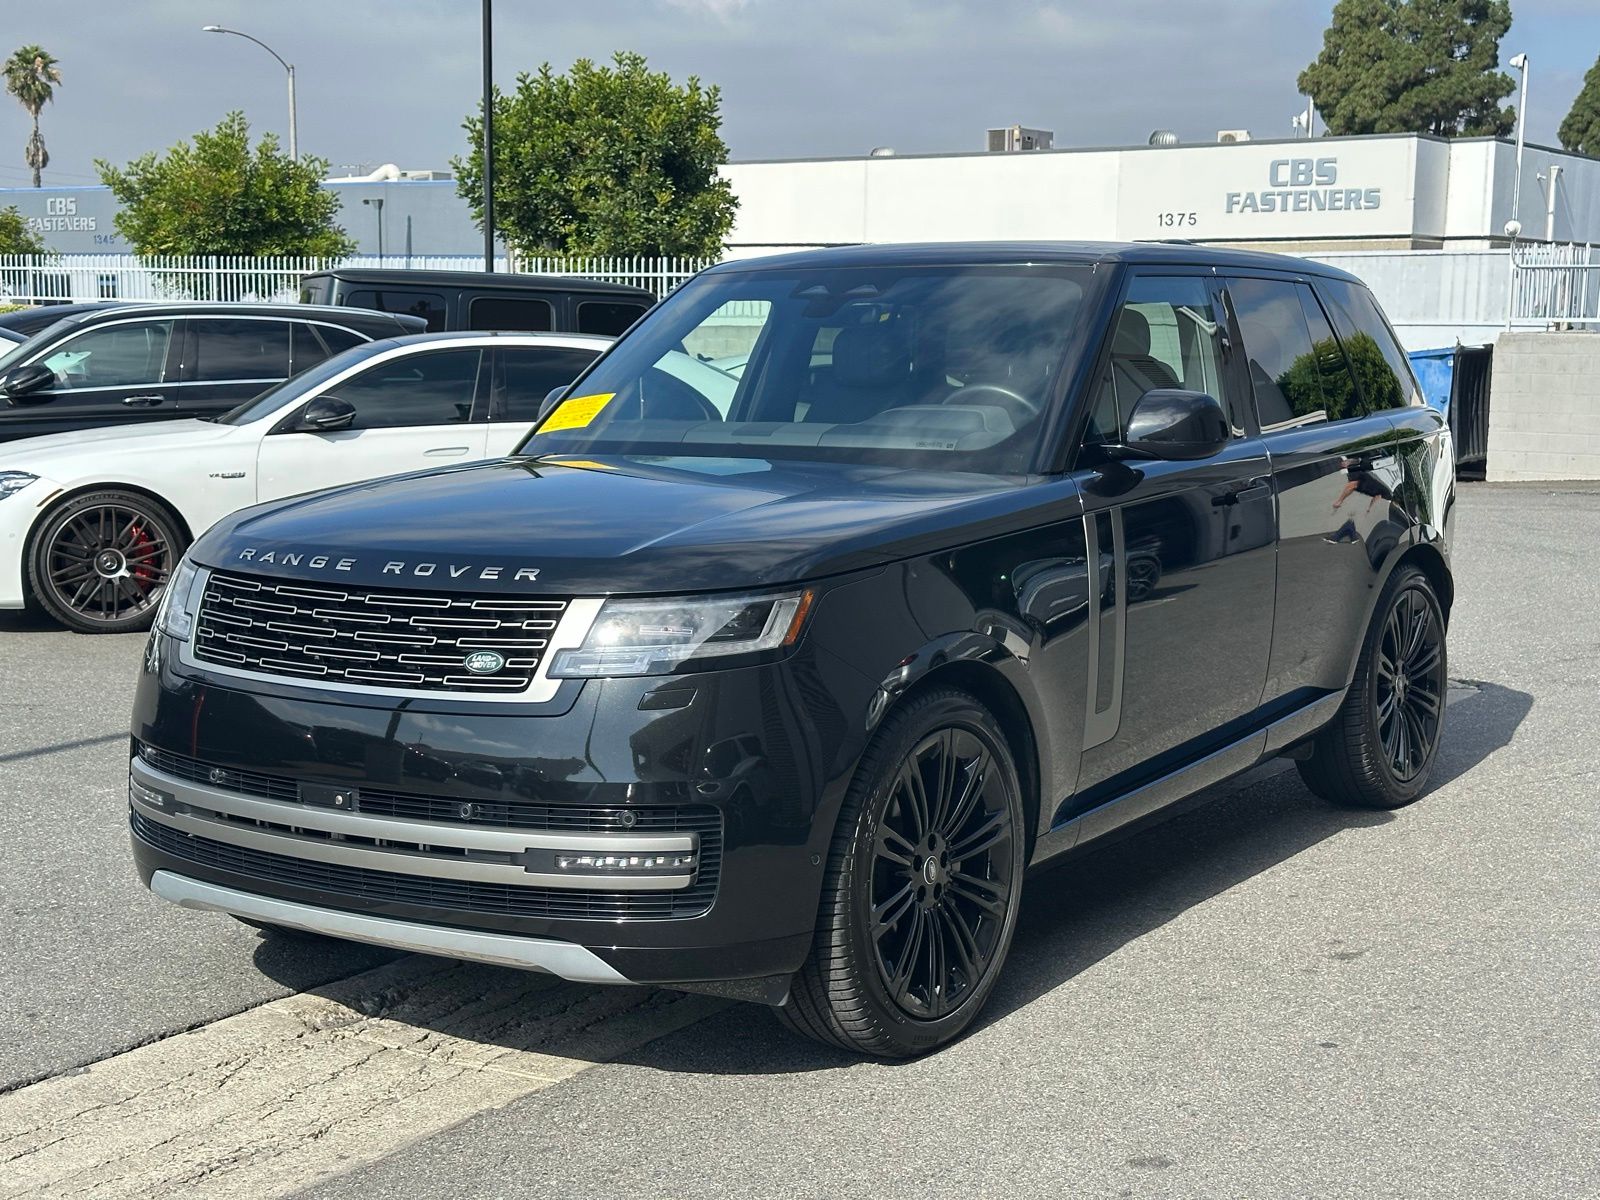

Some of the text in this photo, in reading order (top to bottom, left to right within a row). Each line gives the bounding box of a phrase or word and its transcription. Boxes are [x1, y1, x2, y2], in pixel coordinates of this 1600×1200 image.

[1269, 157, 1338, 187] CBS
[46, 198, 77, 216] CBS
[1225, 187, 1381, 214] FASTENERS
[1157, 212, 1197, 227] 1375
[93, 235, 115, 245] 1345
[239, 548, 541, 581] RANGE ROVER
